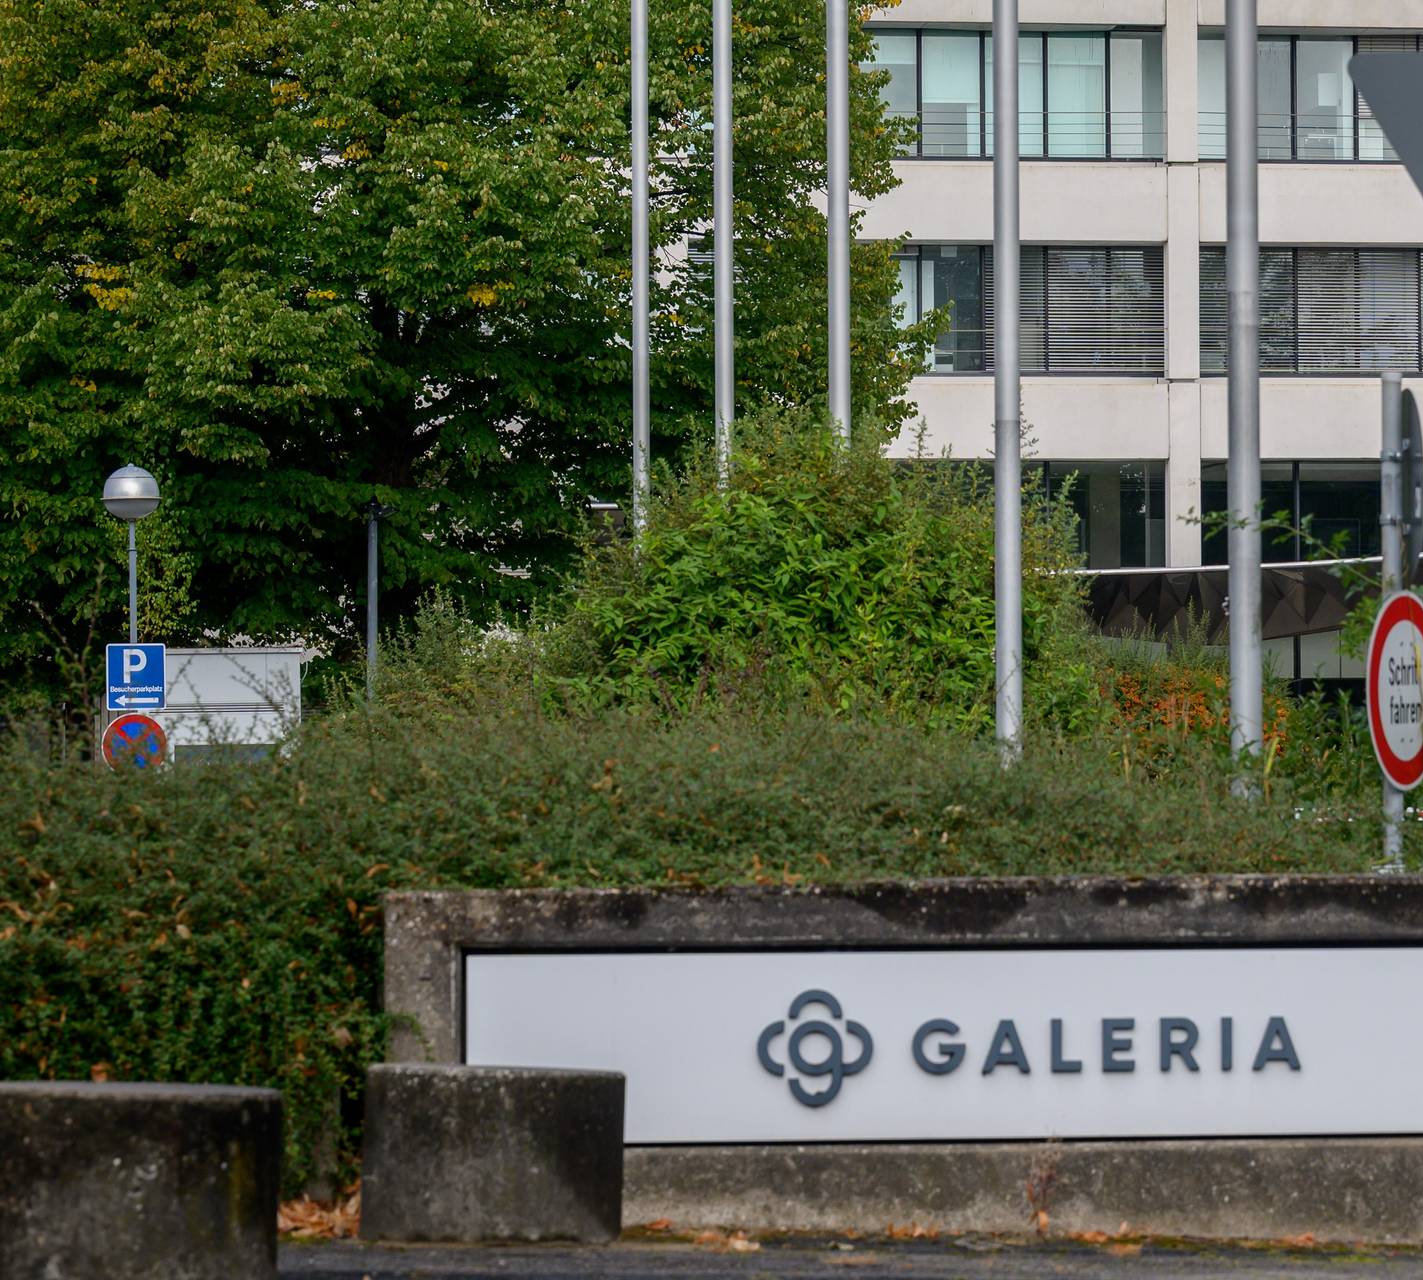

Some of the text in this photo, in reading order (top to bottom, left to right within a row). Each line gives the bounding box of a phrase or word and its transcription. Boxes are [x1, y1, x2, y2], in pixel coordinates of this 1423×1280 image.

[123, 649, 147, 683] P
[1389, 696, 1423, 725] fahren
[911, 1016, 1302, 1077] GALERIA
